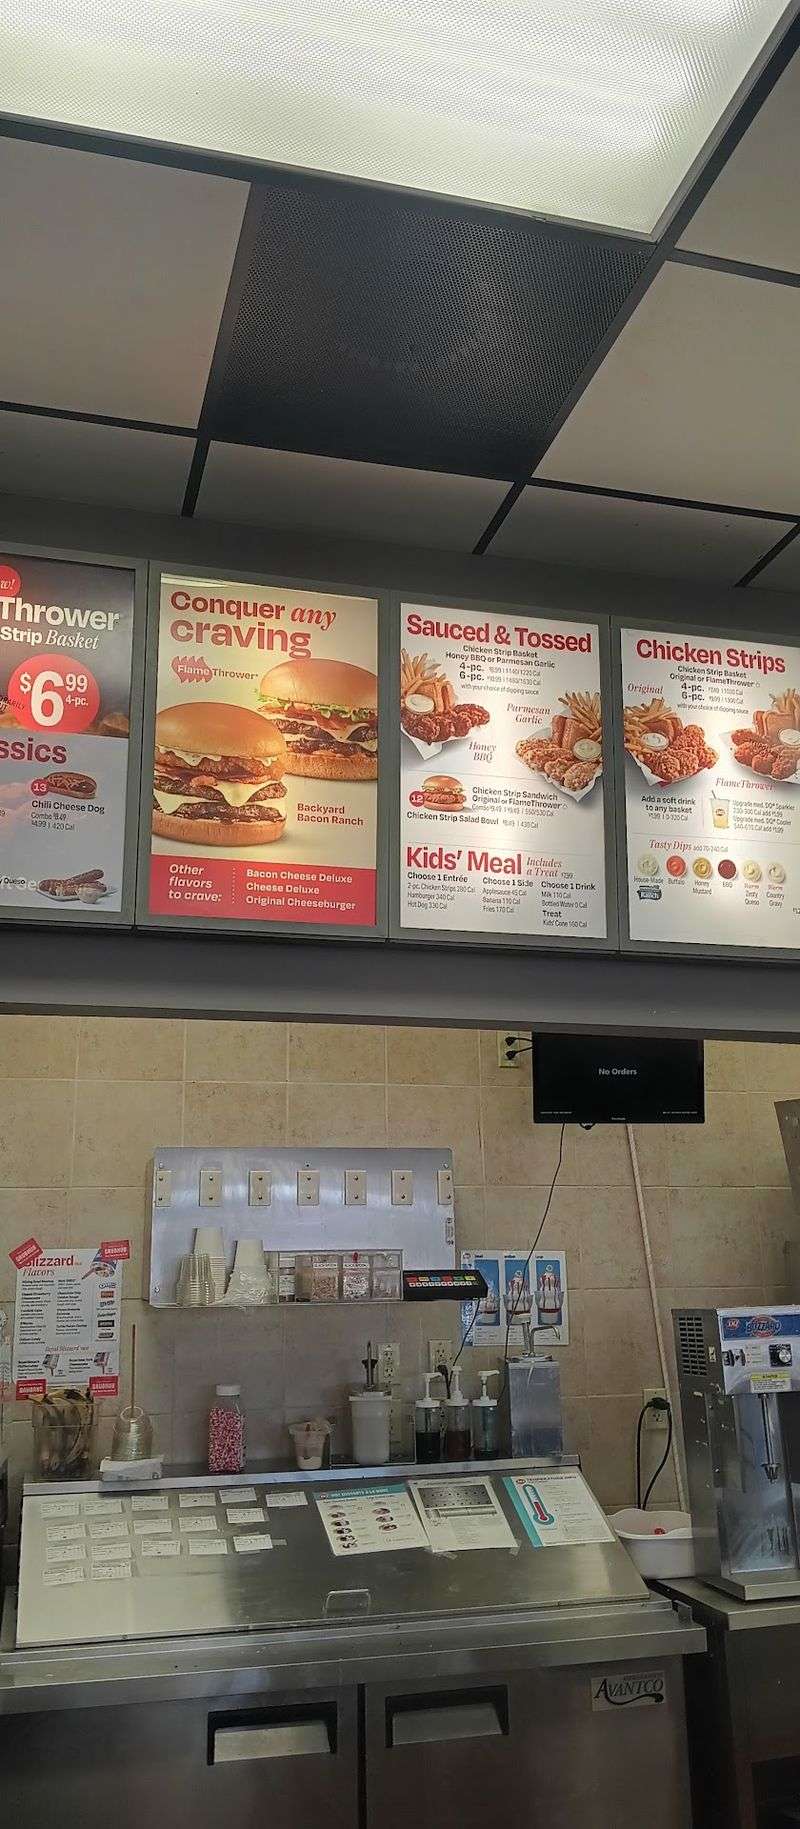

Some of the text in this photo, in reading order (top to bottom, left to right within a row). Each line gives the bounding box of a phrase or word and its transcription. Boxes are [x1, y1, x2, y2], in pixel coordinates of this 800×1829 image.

[1, 597, 121, 631] Thrower
[170, 591, 337, 631] Conquer any
[0, 627, 100, 650] Strip Basket
[407, 614, 592, 653] Sauced & Tossed
[170, 619, 312, 660] craving
[462, 645, 538, 659] Chicken Strip Basket
[636, 638, 786, 675] Chicken Strips
[445, 651, 468, 661] Honey
[470, 653, 487, 663] BBQ
[496, 656, 533, 667] Parmesan
[534, 660, 556, 669] Garlic
[459, 662, 485, 673] 4-pc.
[677, 665, 747, 679] Chicken Strip Basket
[459, 671, 485, 682] 6-pc.
[669, 673, 696, 682] Original
[627, 682, 664, 695] Original
[681, 682, 705, 692] 4-pc.
[66, 695, 89, 706] 4-pc.
[681, 691, 705, 701] 6-pc.
[506, 703, 552, 716] Parmesan
[515, 714, 543, 725] Garlic
[468, 741, 497, 753] Honey
[33, 783, 47, 792] 13
[472, 786, 558, 800] Chicken Strip Sandwich
[472, 794, 500, 805] Original
[641, 795, 656, 803] Add
[662, 796, 677, 804] soft
[677, 797, 696, 805] drink
[31, 800, 105, 815] Chili Cheese Dog
[297, 803, 345, 815] Backyard
[654, 805, 667, 813] any
[668, 805, 693, 814] basket
[31, 812, 52, 820] Combo
[297, 813, 364, 827] Bacon Ranch
[406, 811, 438, 820] Chicken
[439, 813, 458, 823] Strip
[459, 815, 480, 824] Salad
[480, 816, 499, 825] Bowl
[65, 823, 75, 831] Cal
[649, 839, 692, 852] Tasty Dips
[407, 847, 562, 874] Kids' Meal Includes
[169, 863, 204, 876] Other
[534, 867, 558, 878] Treat
[3, 877, 26, 885] Queso
[246, 869, 353, 884] Bacon Cheese Deluxe
[407, 872, 436, 881] Choose
[443, 873, 468, 883] Entrée
[168, 876, 213, 889] flavors
[482, 877, 510, 886] Choose
[517, 880, 533, 888] Side
[541, 881, 569, 890] Choose
[575, 883, 596, 891] Drink
[694, 880, 710, 888] Honey
[246, 883, 320, 895] Cheese Deluxe
[692, 887, 712, 895] Mustard
[168, 889, 222, 902] to crave:
[407, 892, 435, 901] Hamburger
[246, 895, 356, 911] Original Cheeseburger
[417, 901, 428, 910] Dog
[439, 902, 448, 910] Cal
[579, 901, 588, 909] Cal
[542, 910, 562, 918] Treat
[554, 920, 569, 928] Cone
[598, 1068, 638, 1076] No Orders
[23, 1268, 55, 1277] Flavors
[593, 1678, 664, 1702] AVANTCO
